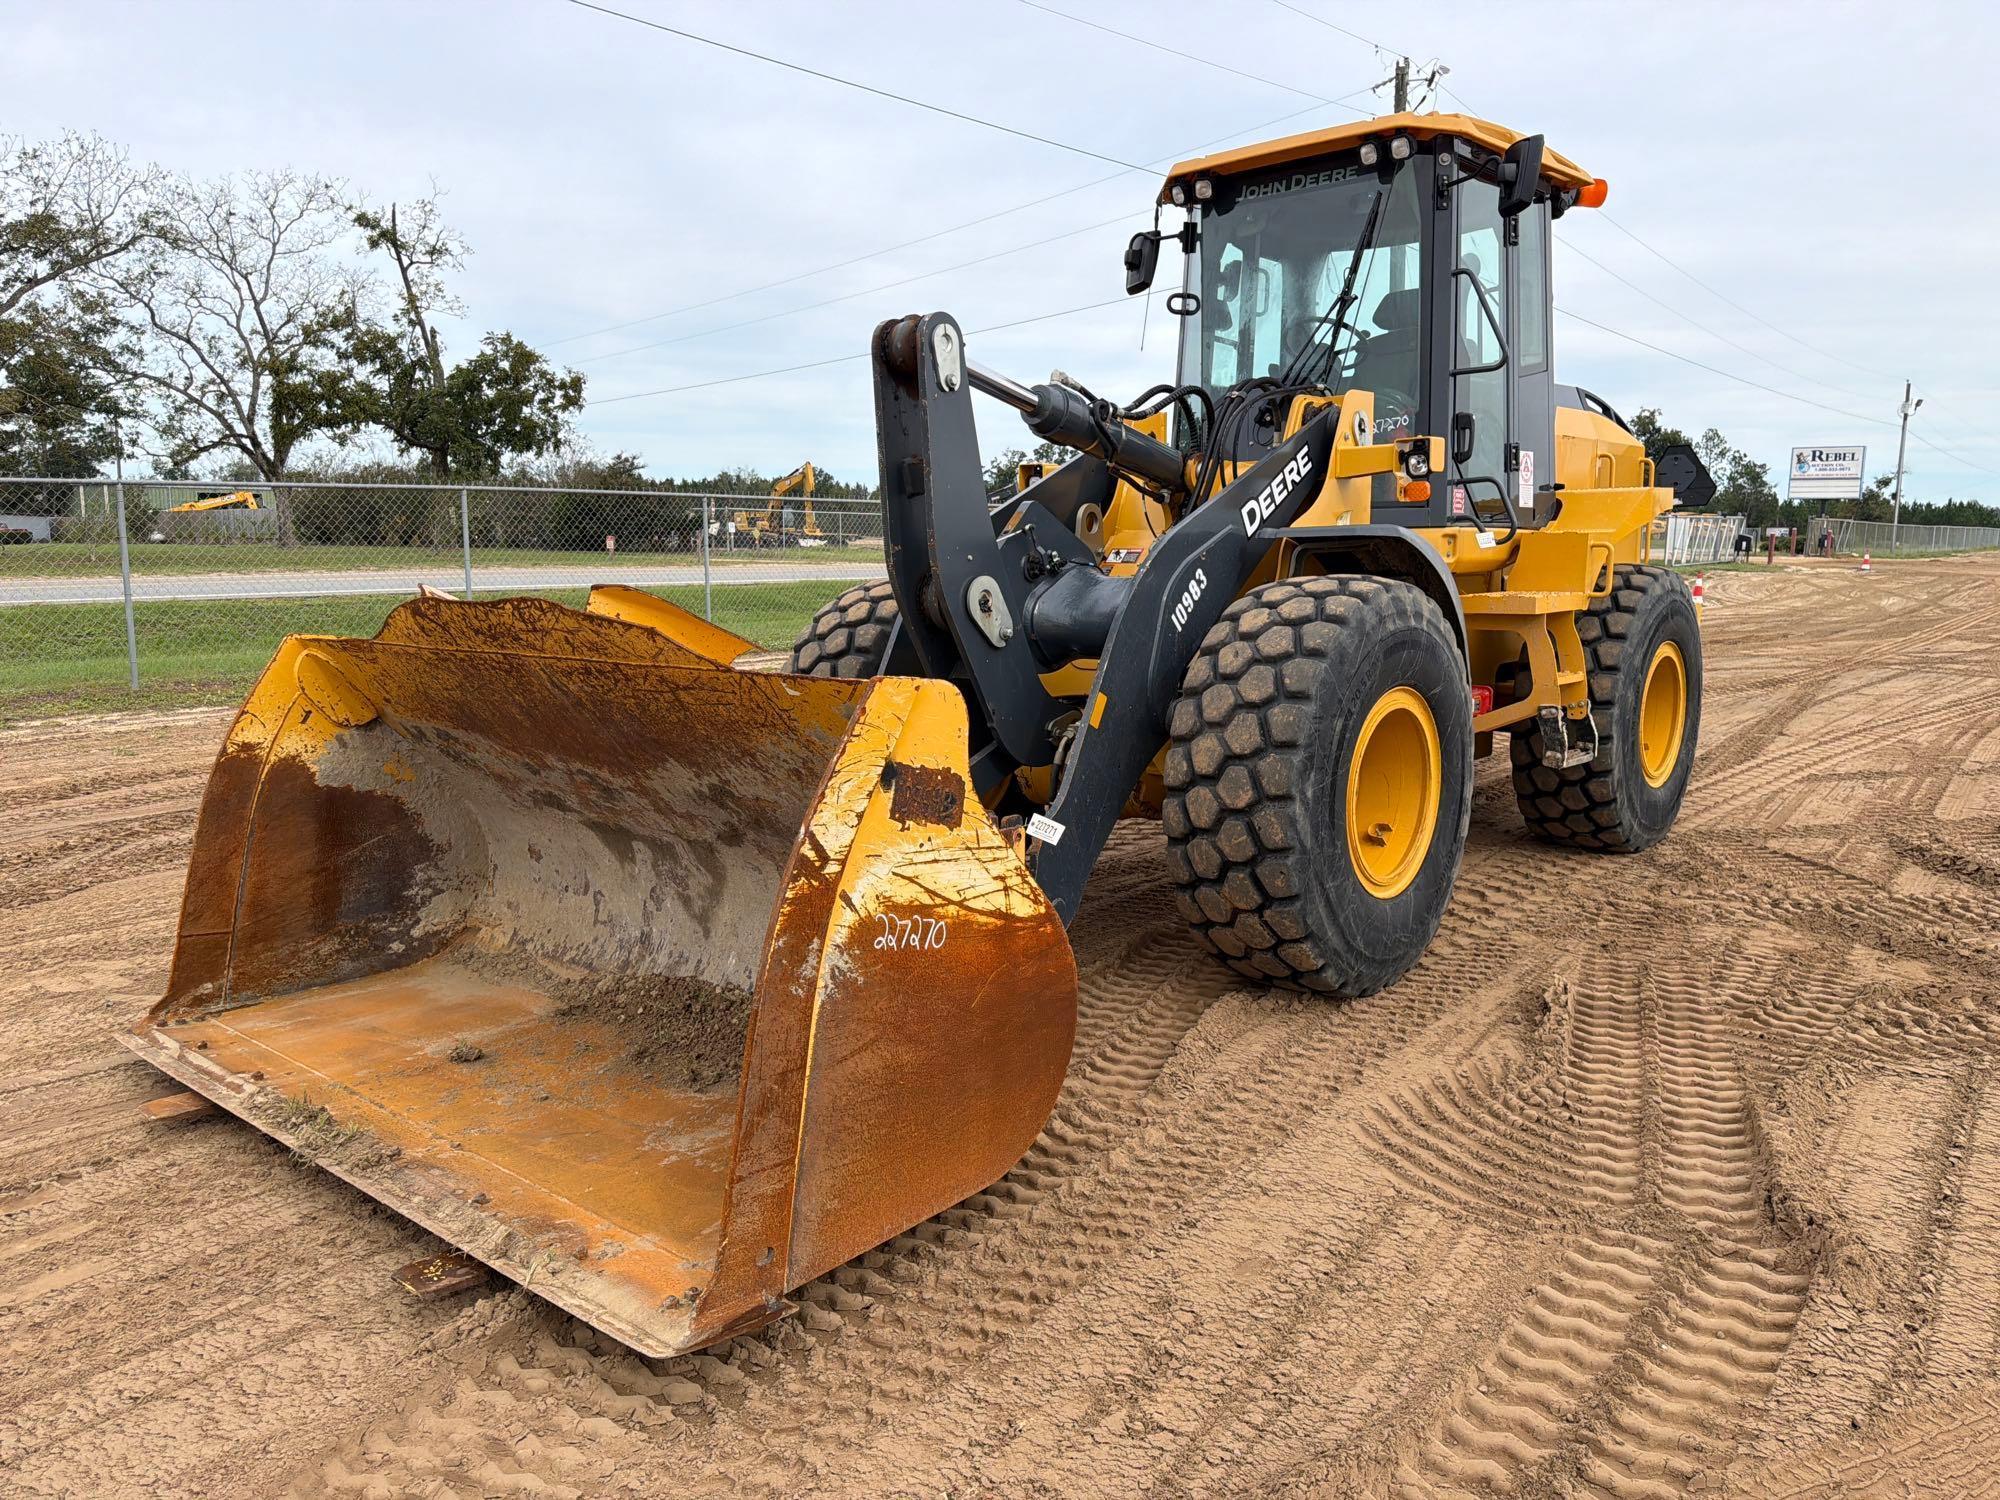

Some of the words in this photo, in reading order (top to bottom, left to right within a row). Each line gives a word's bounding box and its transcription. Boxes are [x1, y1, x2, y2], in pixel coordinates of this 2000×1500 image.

[1235, 180, 1287, 202] JOHN
[1290, 165, 1358, 191] DEERE
[1240, 444, 1313, 537] DEERE
[1171, 567, 1208, 633] 10983
[873, 913, 946, 952] 227270
